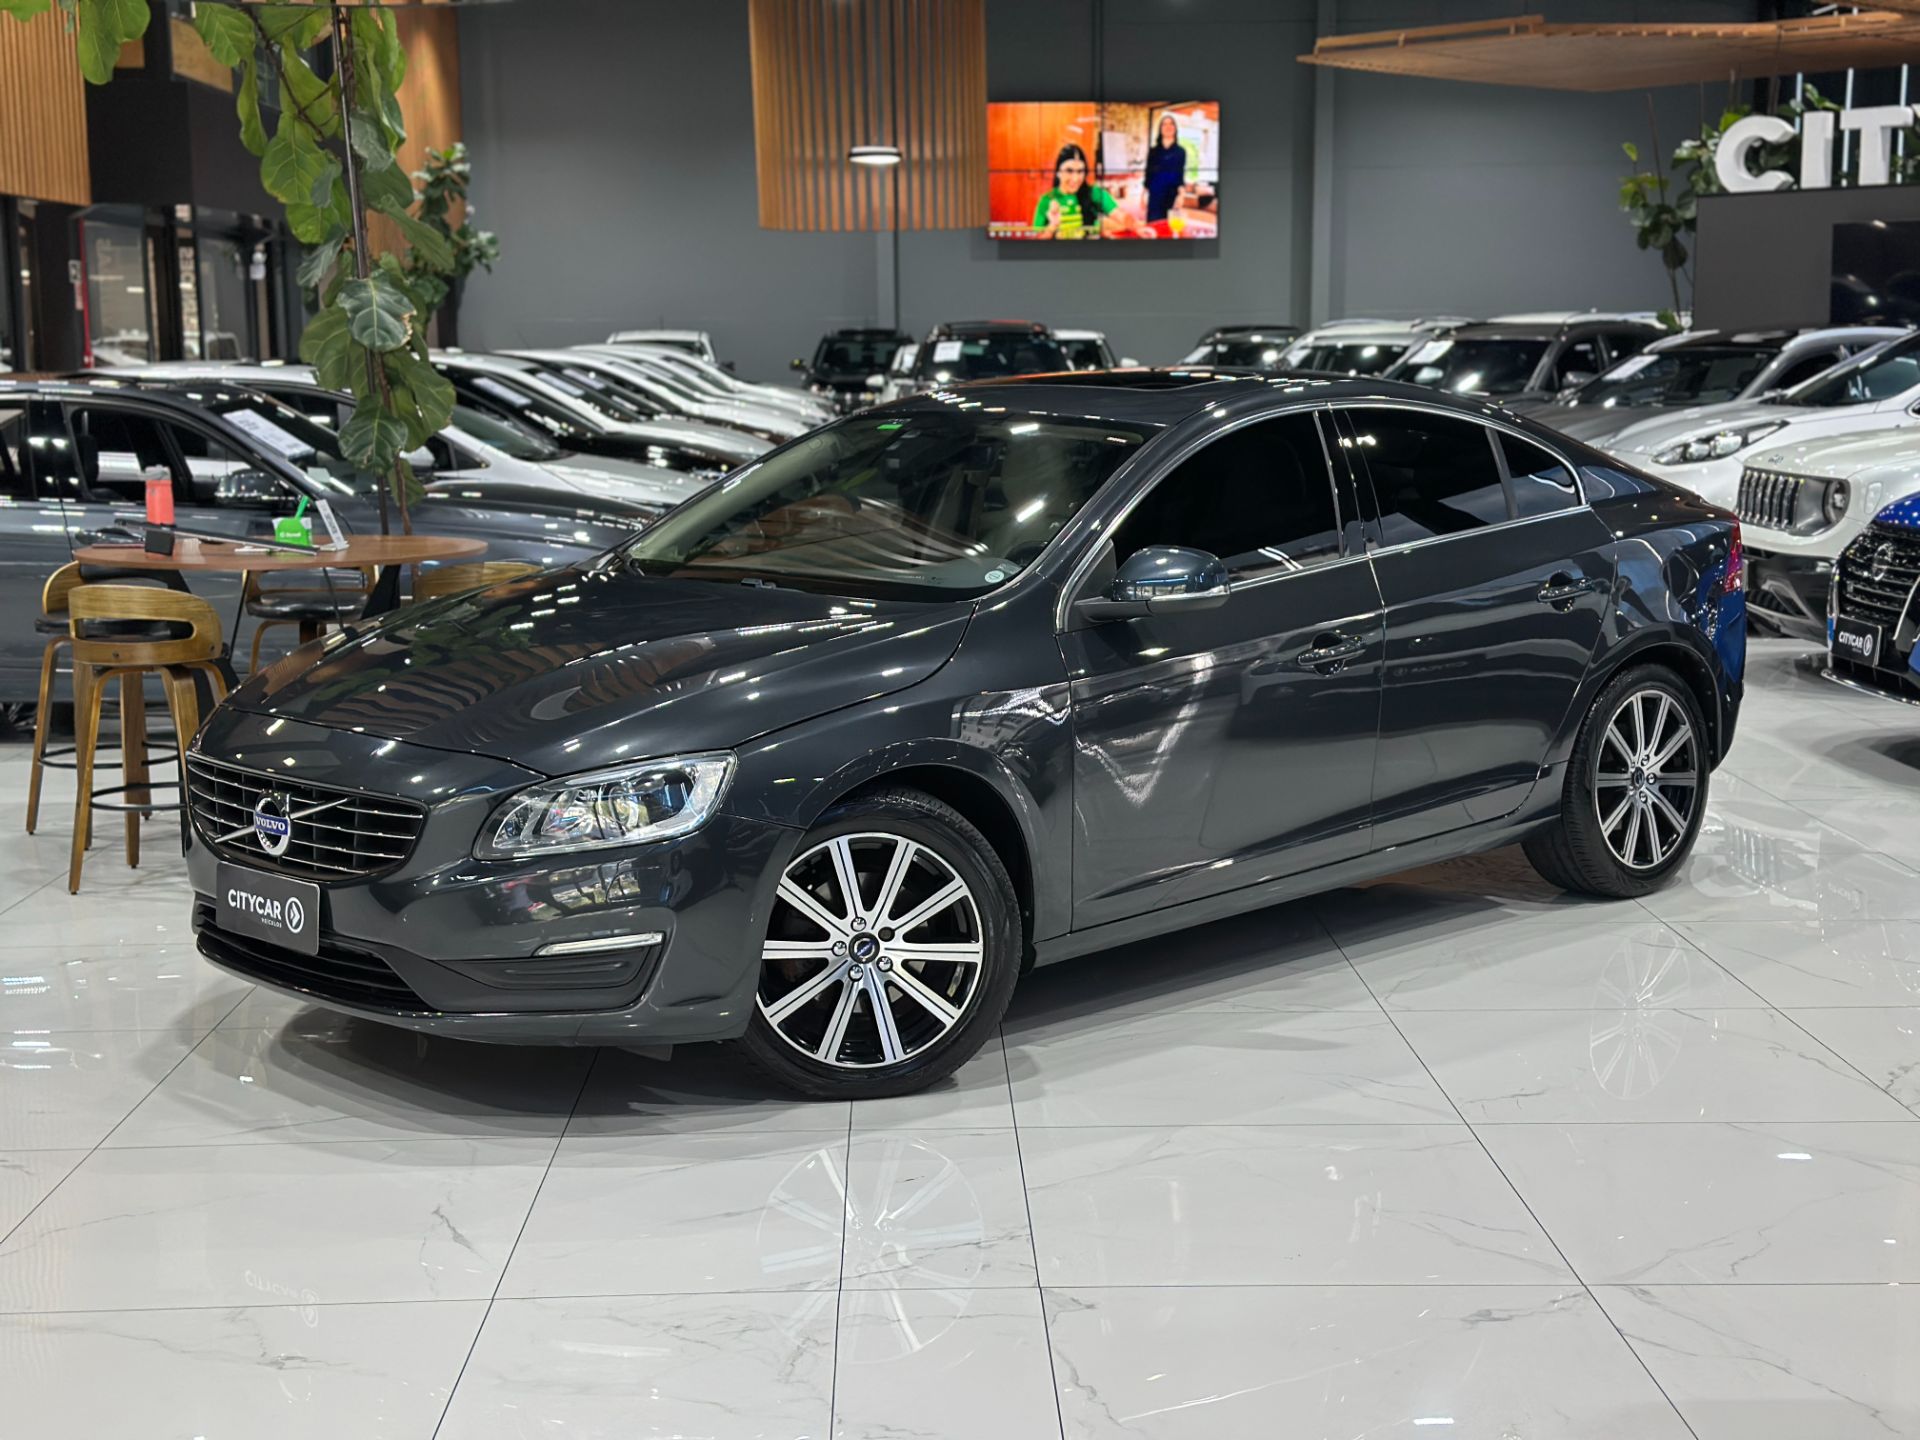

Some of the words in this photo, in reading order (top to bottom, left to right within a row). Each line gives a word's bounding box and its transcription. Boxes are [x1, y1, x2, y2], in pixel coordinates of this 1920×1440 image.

[1715, 104, 1920, 193] CIT
[1838, 631, 1864, 649] CITYCAR
[256, 816, 286, 831] VOLVO
[227, 888, 282, 920] CITYCAR
